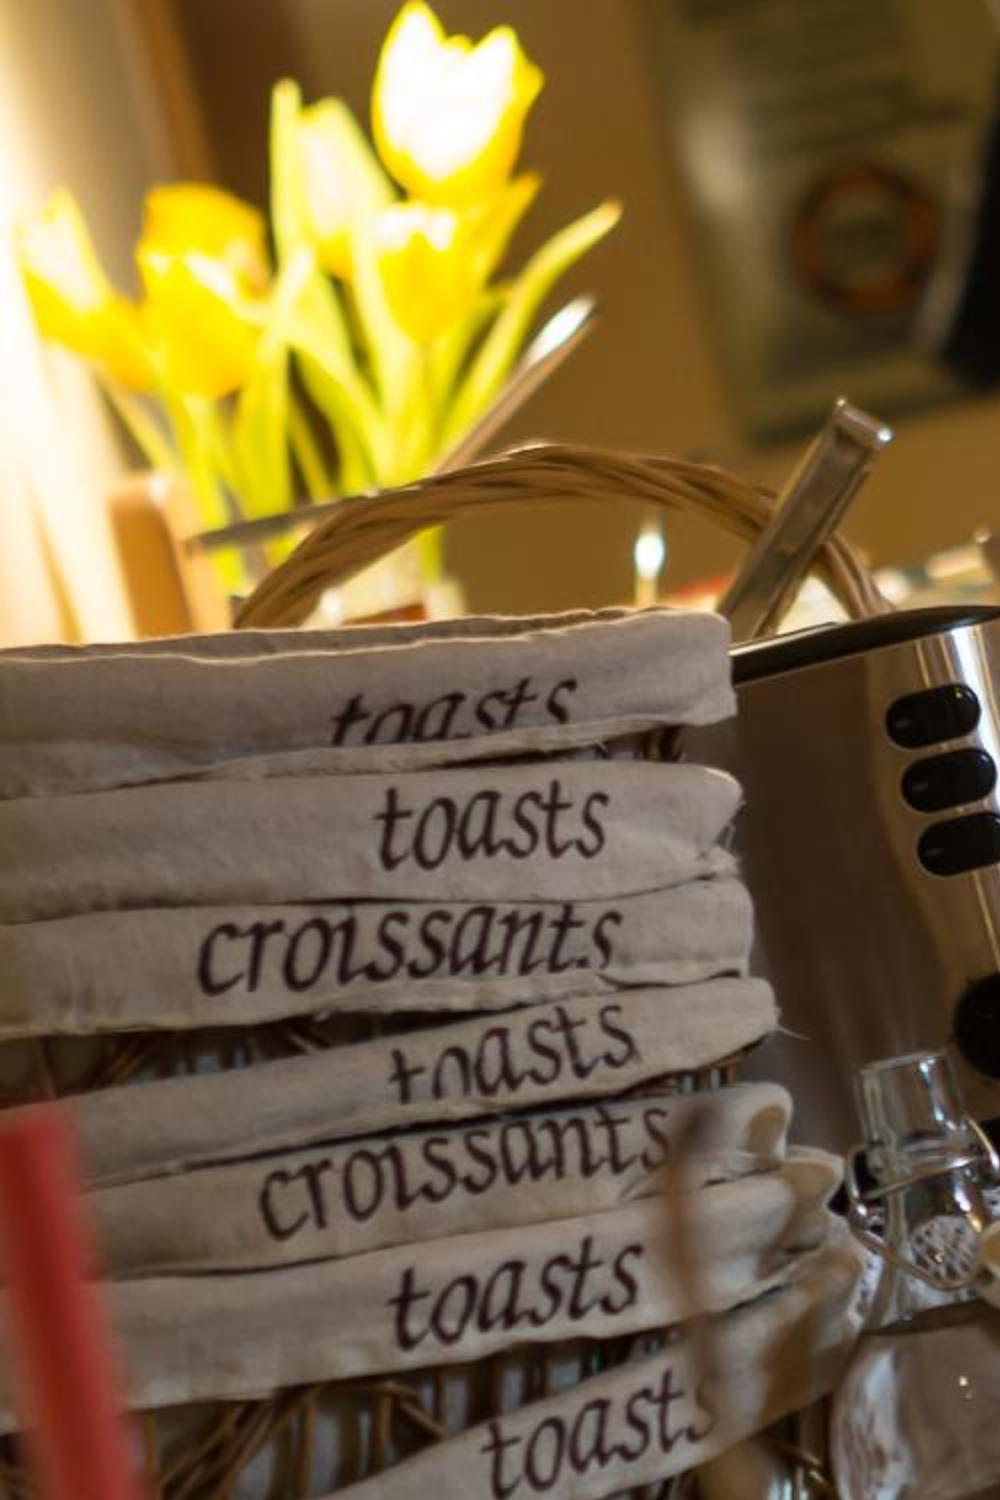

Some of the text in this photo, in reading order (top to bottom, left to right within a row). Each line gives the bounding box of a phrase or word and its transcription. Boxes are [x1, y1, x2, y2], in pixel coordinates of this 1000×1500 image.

[372, 780, 610, 872] toasts
[197, 903, 624, 997] croissants
[388, 1003, 638, 1105] toasts
[257, 1104, 673, 1243] croissants
[384, 1235, 644, 1353] toasts
